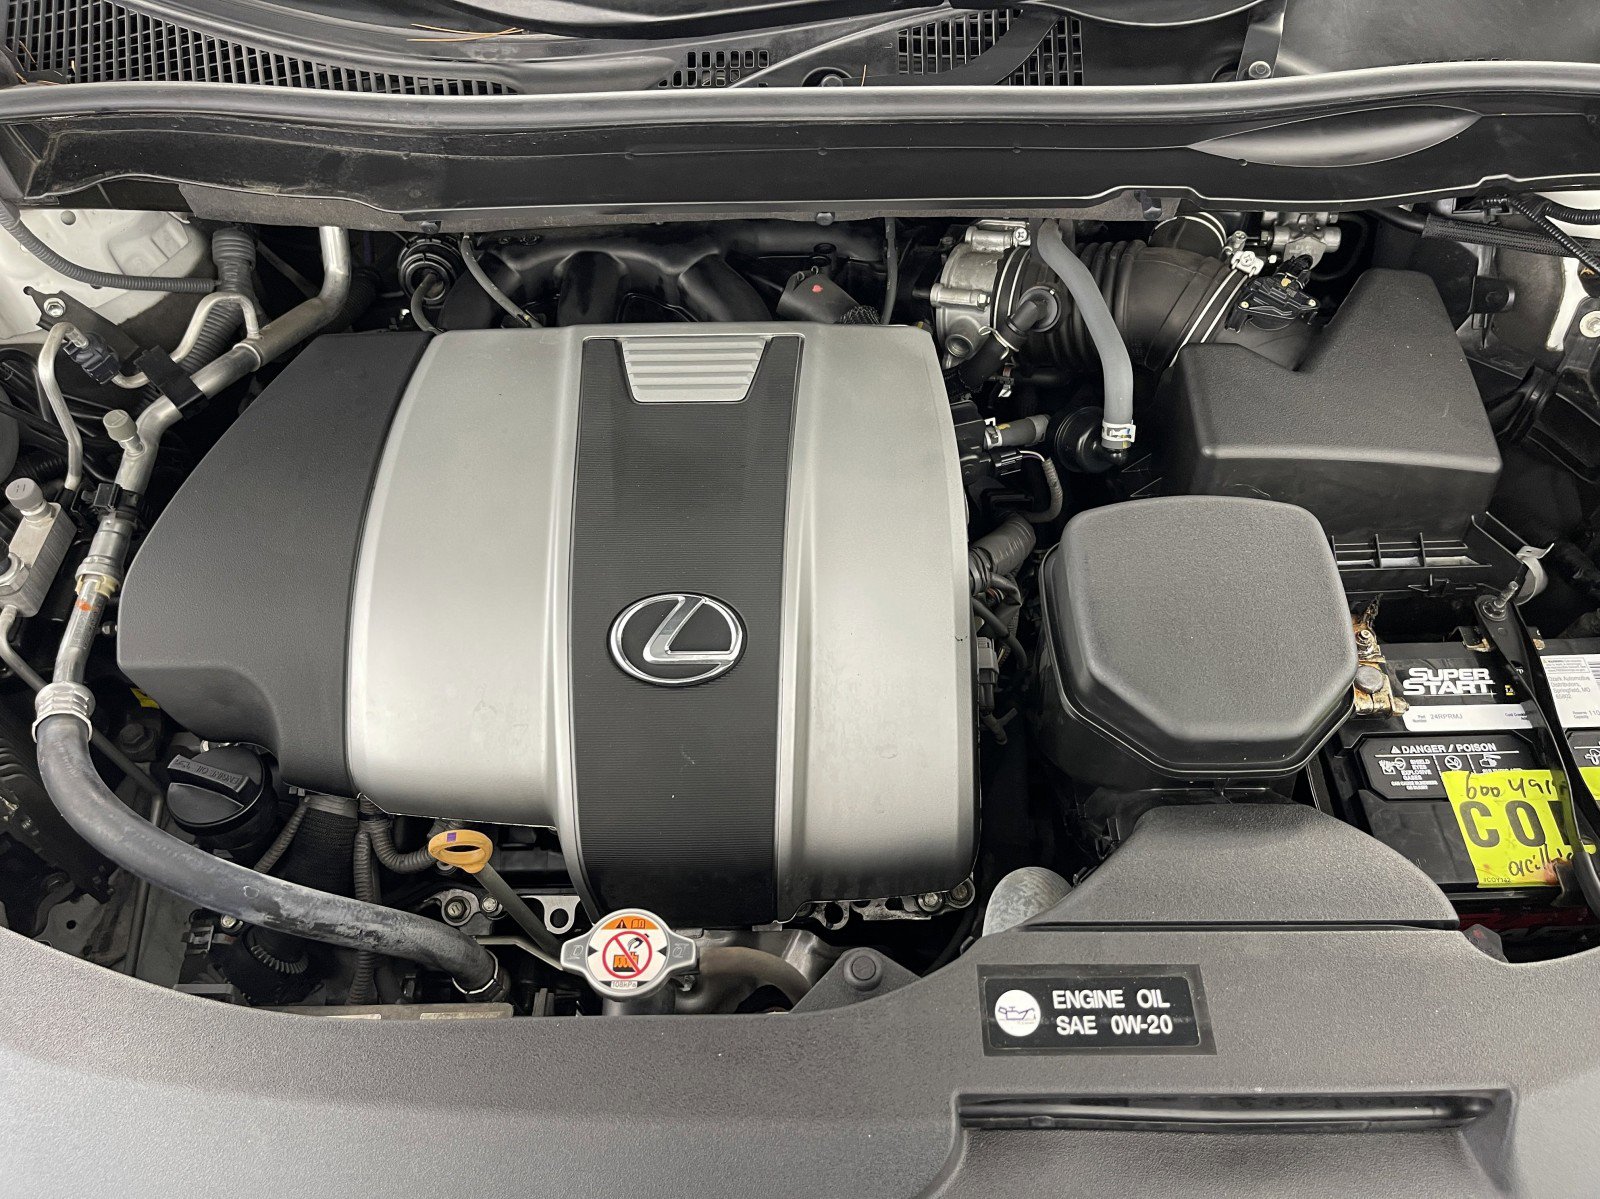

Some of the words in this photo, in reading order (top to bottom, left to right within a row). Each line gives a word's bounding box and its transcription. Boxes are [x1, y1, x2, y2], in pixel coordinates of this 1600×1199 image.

[1408, 667, 1491, 682] SUPER
[1403, 680, 1496, 695] START
[1401, 744, 1447, 754] DANGER
[1456, 743, 1497, 752] POISON
[1052, 989, 1125, 1009] ENGINE
[1136, 989, 1170, 1009] OIL
[1056, 1015, 1098, 1035] SAE
[1110, 1014, 1174, 1035] 0W-20
